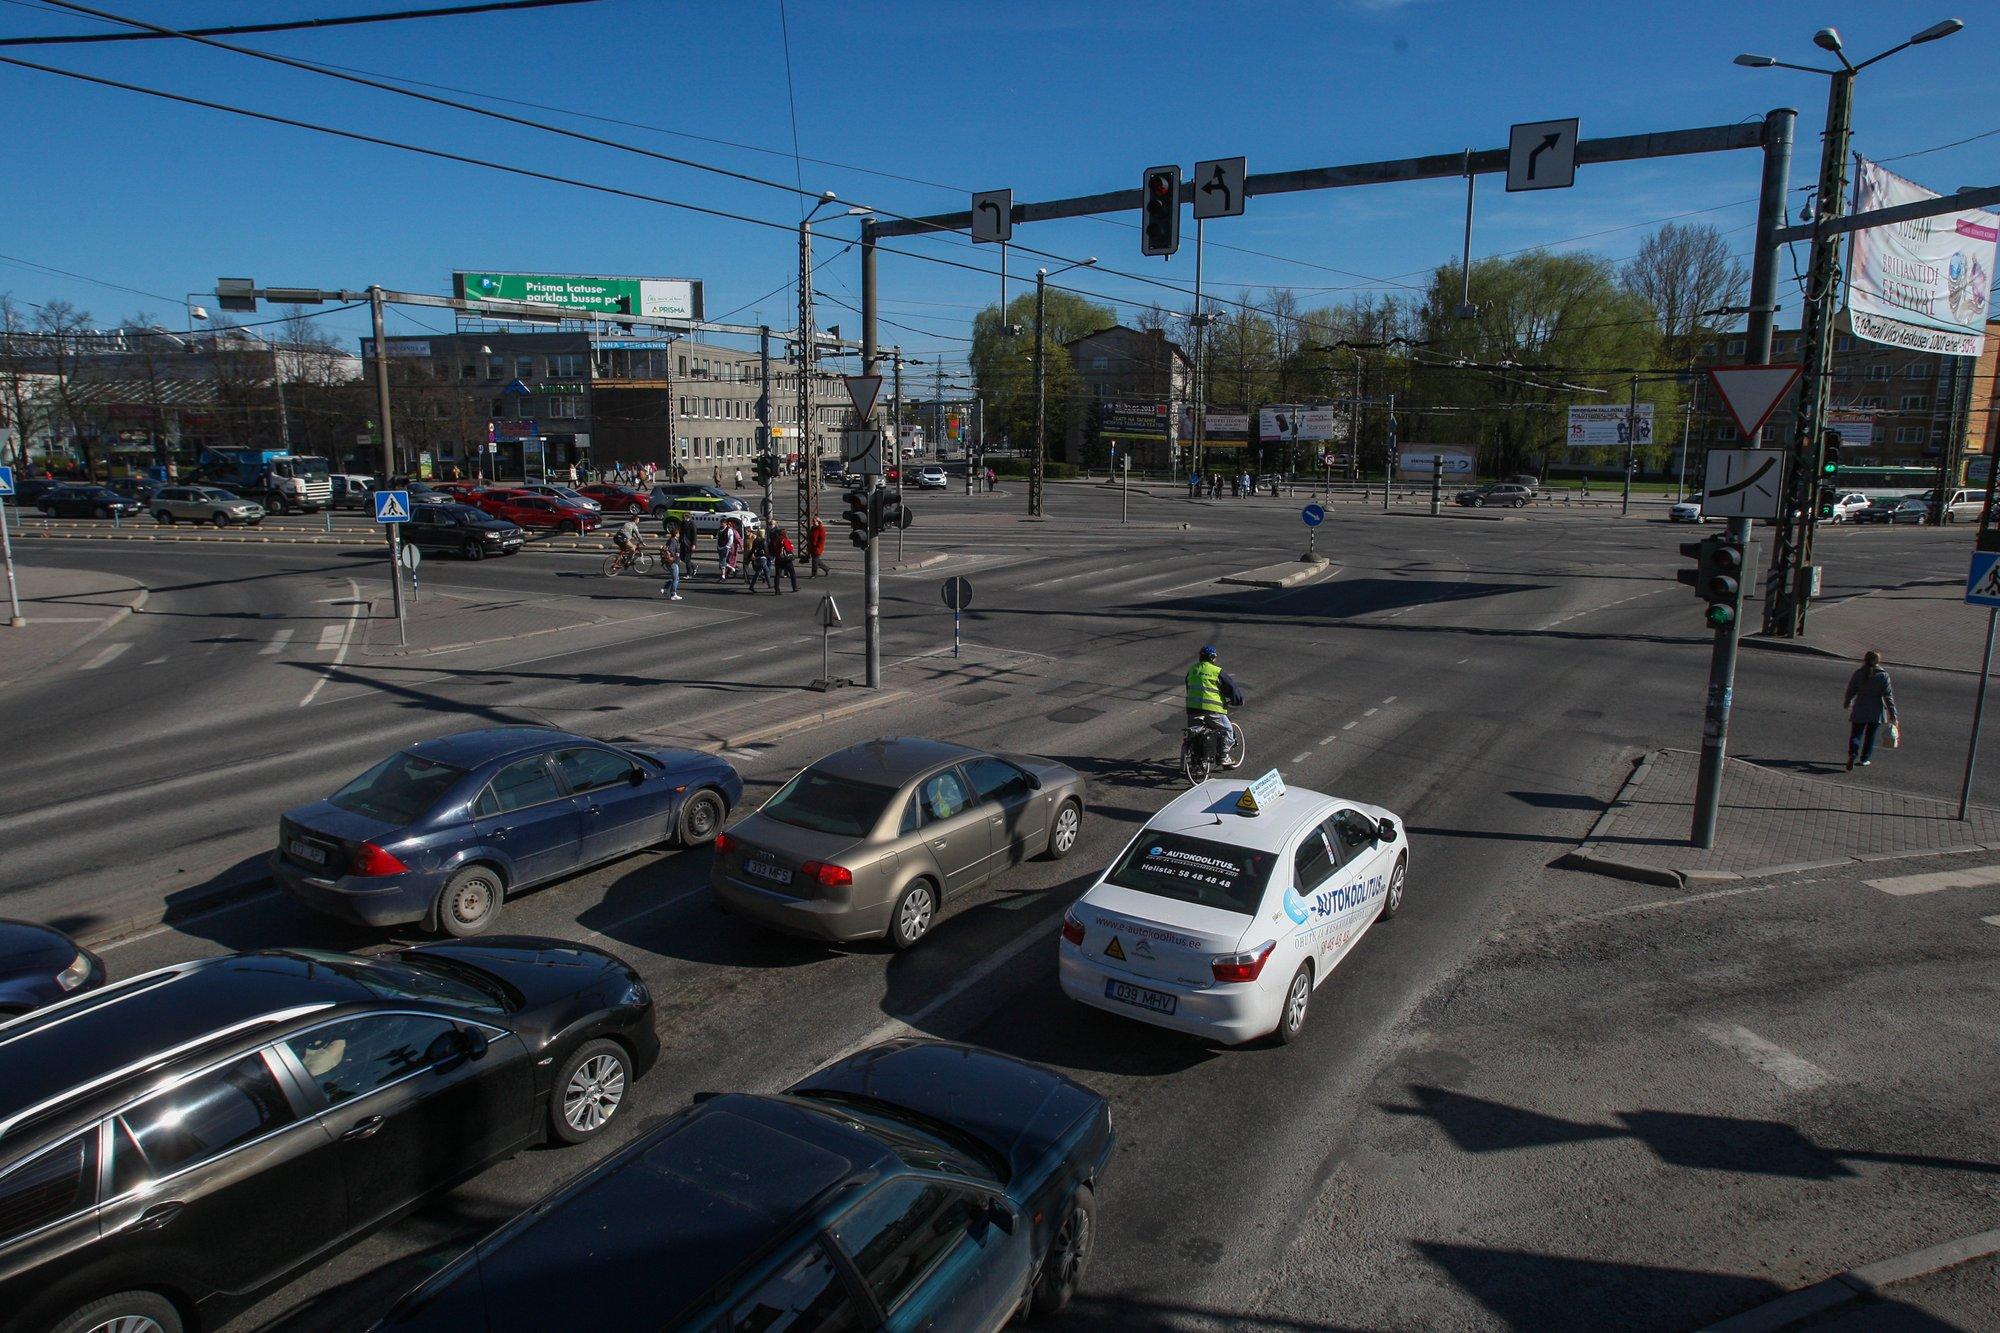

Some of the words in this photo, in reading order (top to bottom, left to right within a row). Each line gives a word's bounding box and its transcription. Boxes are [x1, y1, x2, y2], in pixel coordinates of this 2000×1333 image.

[526, 282, 564, 293] Prisma
[566, 284, 606, 294] katuse-
[571, 293, 602, 304] busse
[752, 862, 767, 873] 333
[1141, 864, 1176, 876] Helista:
[1178, 869, 1190, 878] 58
[1192, 873, 1204, 881] 48
[1205, 876, 1218, 884] 48
[1219, 879, 1231, 888] 48
[1095, 916, 1202, 950] www.e-autokoolitus.ee
[1116, 984, 1138, 1001] 039
[1142, 992, 1171, 1009] MHV
